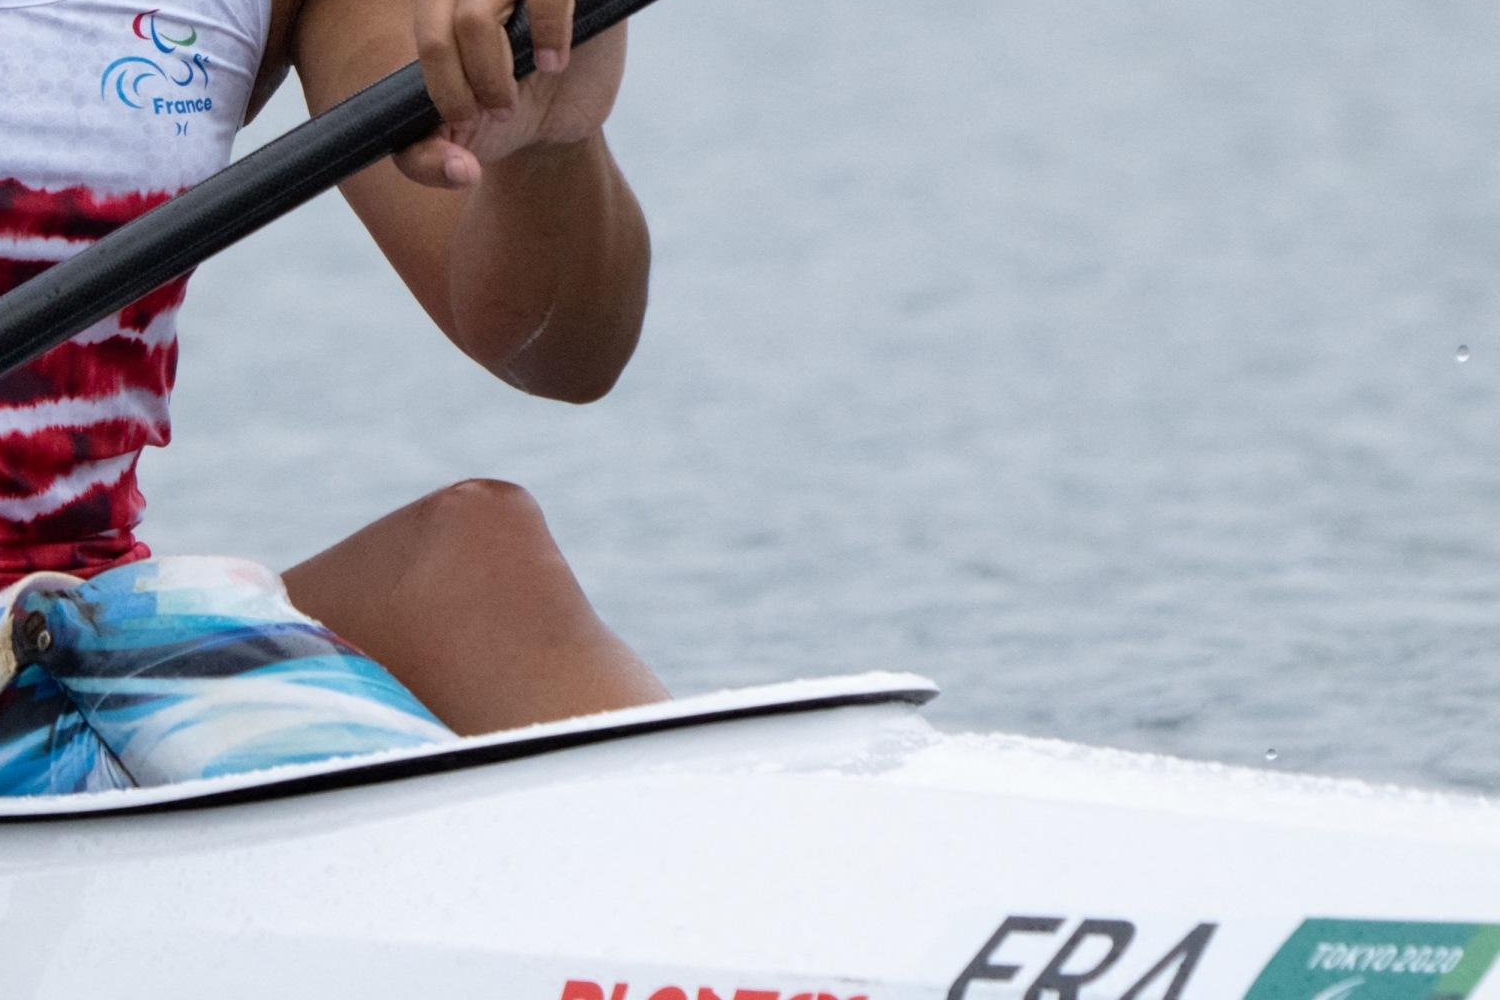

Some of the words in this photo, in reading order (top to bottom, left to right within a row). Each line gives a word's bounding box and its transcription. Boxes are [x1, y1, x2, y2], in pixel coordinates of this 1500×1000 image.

[153, 97, 213, 115] France
[946, 916, 1219, 1000] FRA
[1308, 942, 1398, 971] TOKYO
[1391, 945, 1464, 974] 2020
